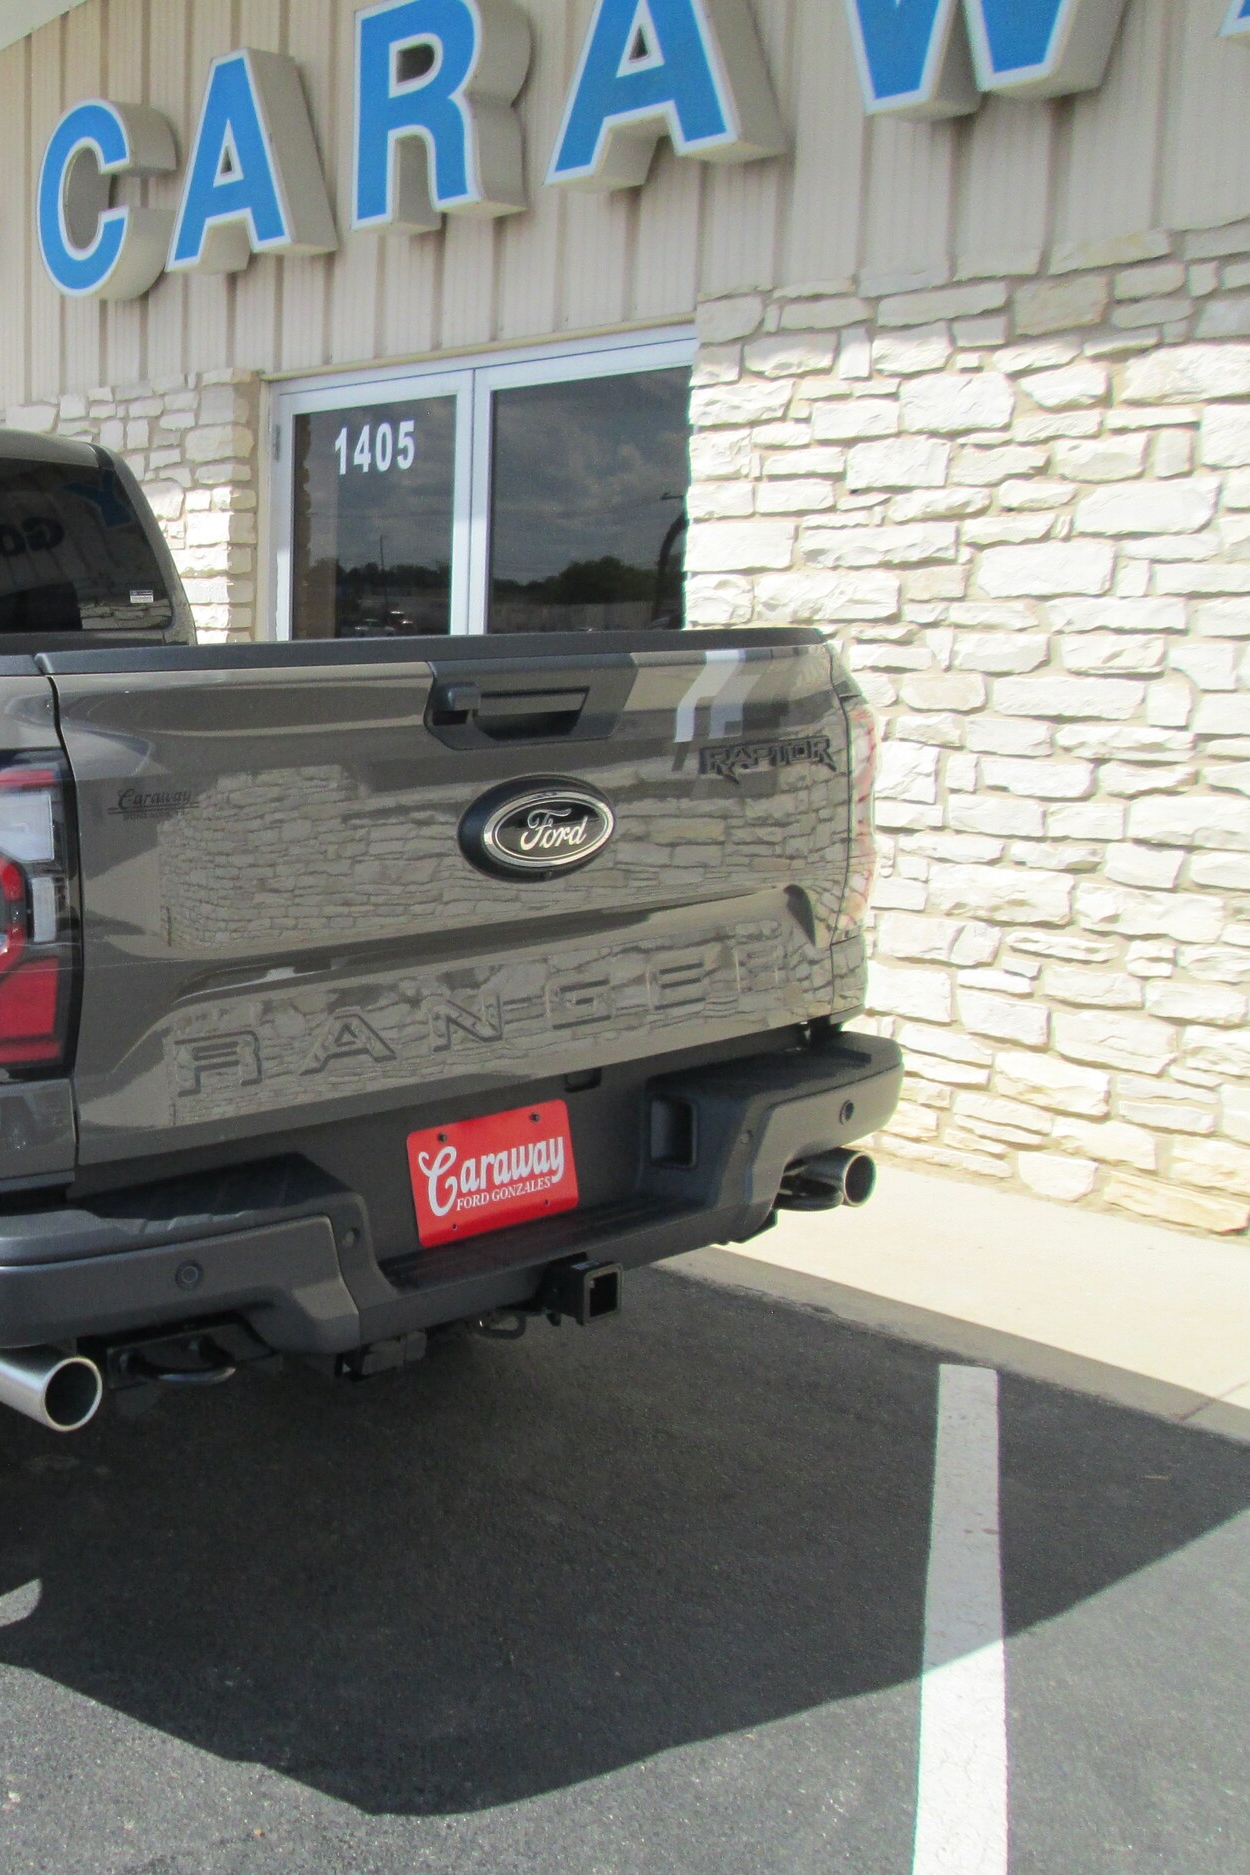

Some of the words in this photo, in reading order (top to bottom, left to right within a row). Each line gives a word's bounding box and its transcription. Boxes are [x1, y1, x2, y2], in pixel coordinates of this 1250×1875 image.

[37, 0, 1250, 299] CARA
[334, 420, 415, 475] 1405
[699, 734, 837, 784] RAPTOR
[117, 788, 193, 811] Caraway
[520, 808, 588, 851] Ford
[173, 919, 790, 1098] RANGER
[418, 1137, 565, 1217] Caraway
[456, 1193, 490, 1212] FORD
[491, 1175, 552, 1202] GONZALES
